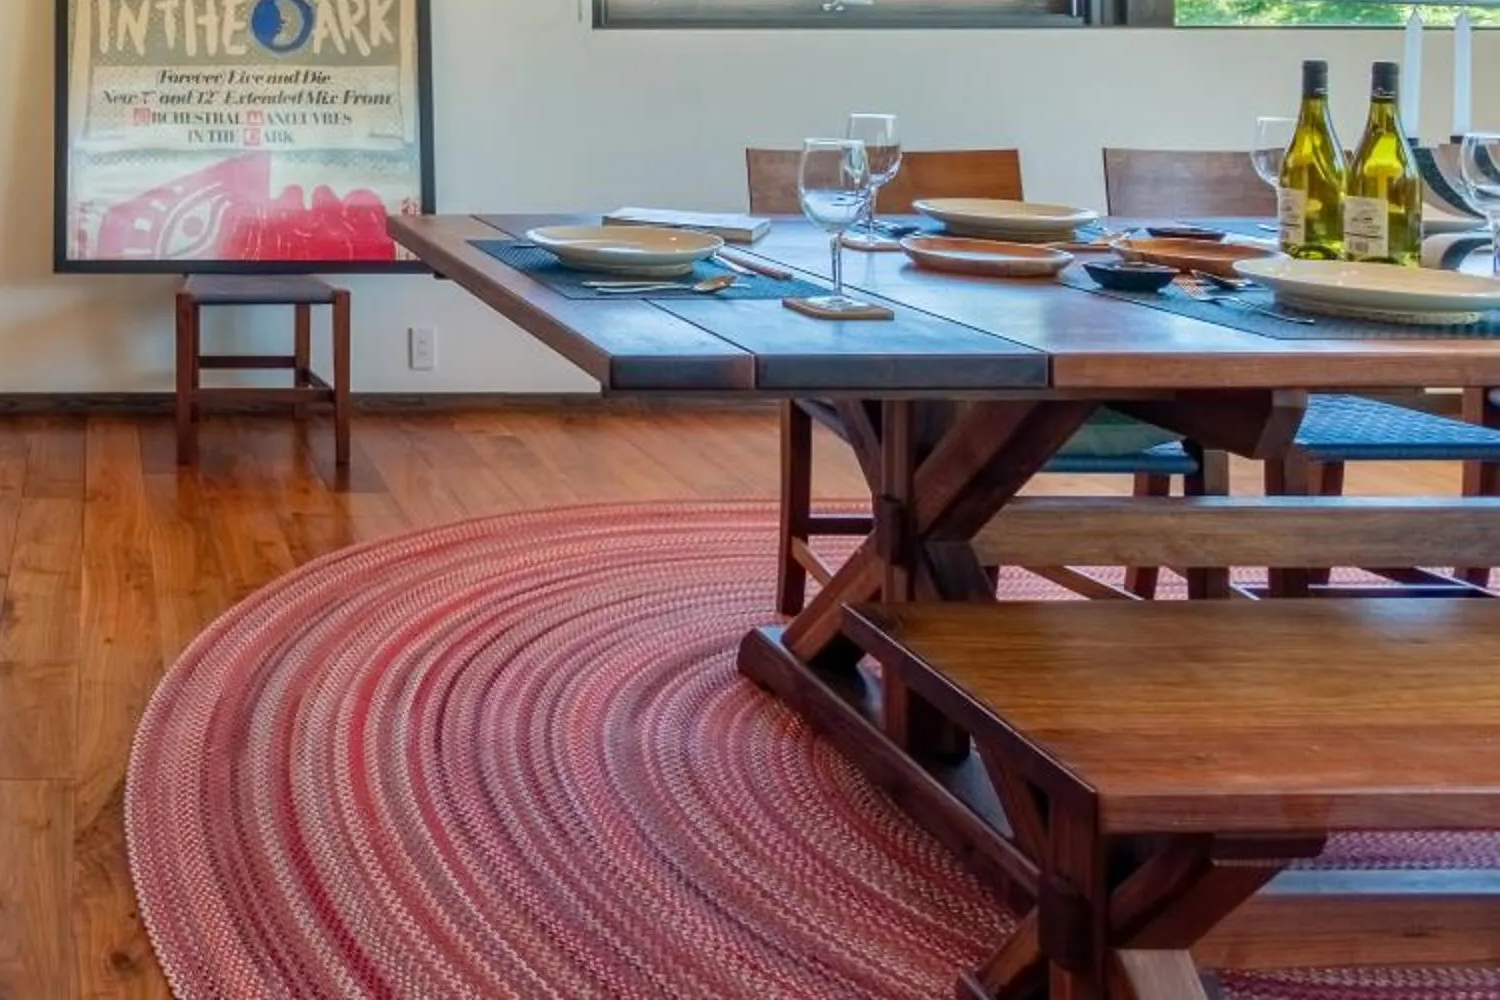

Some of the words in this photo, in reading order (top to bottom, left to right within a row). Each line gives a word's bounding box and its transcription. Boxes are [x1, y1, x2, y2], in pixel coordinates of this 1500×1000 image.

[265, 70, 301, 85] and
[159, 89, 193, 105] and
[342, 89, 393, 105] From
